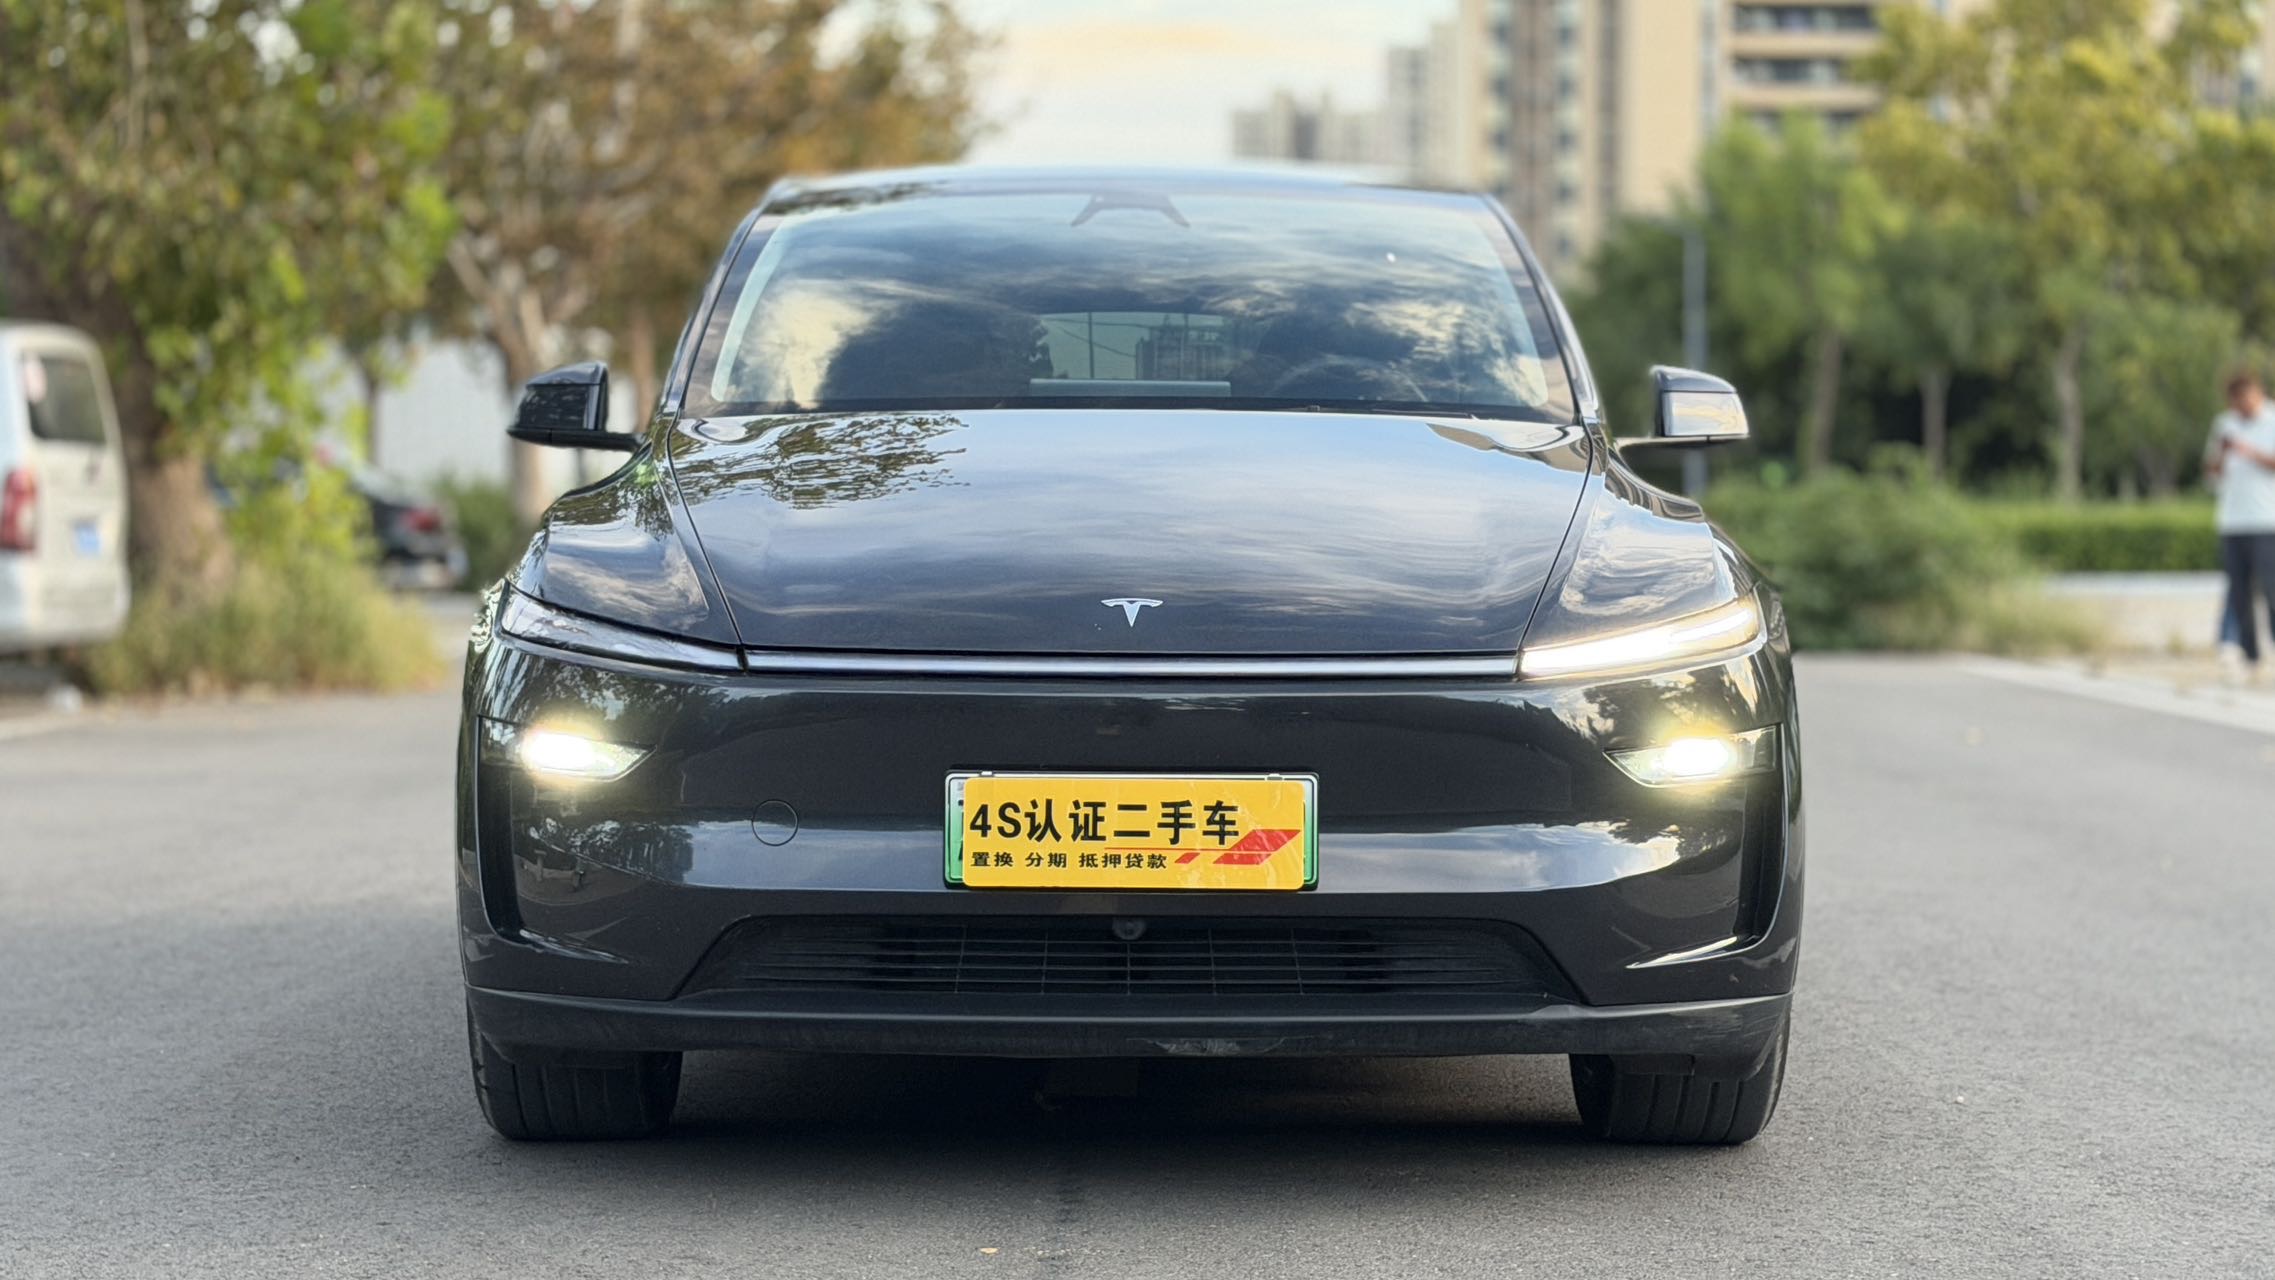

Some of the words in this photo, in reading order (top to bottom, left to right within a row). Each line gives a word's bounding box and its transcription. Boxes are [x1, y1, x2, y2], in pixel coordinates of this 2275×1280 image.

[969, 798, 1240, 846] 4S认证二手车
[971, 851, 1014, 867] 置换
[1025, 852, 1067, 868] 分期
[1078, 852, 1168, 869] 抵押贷款
